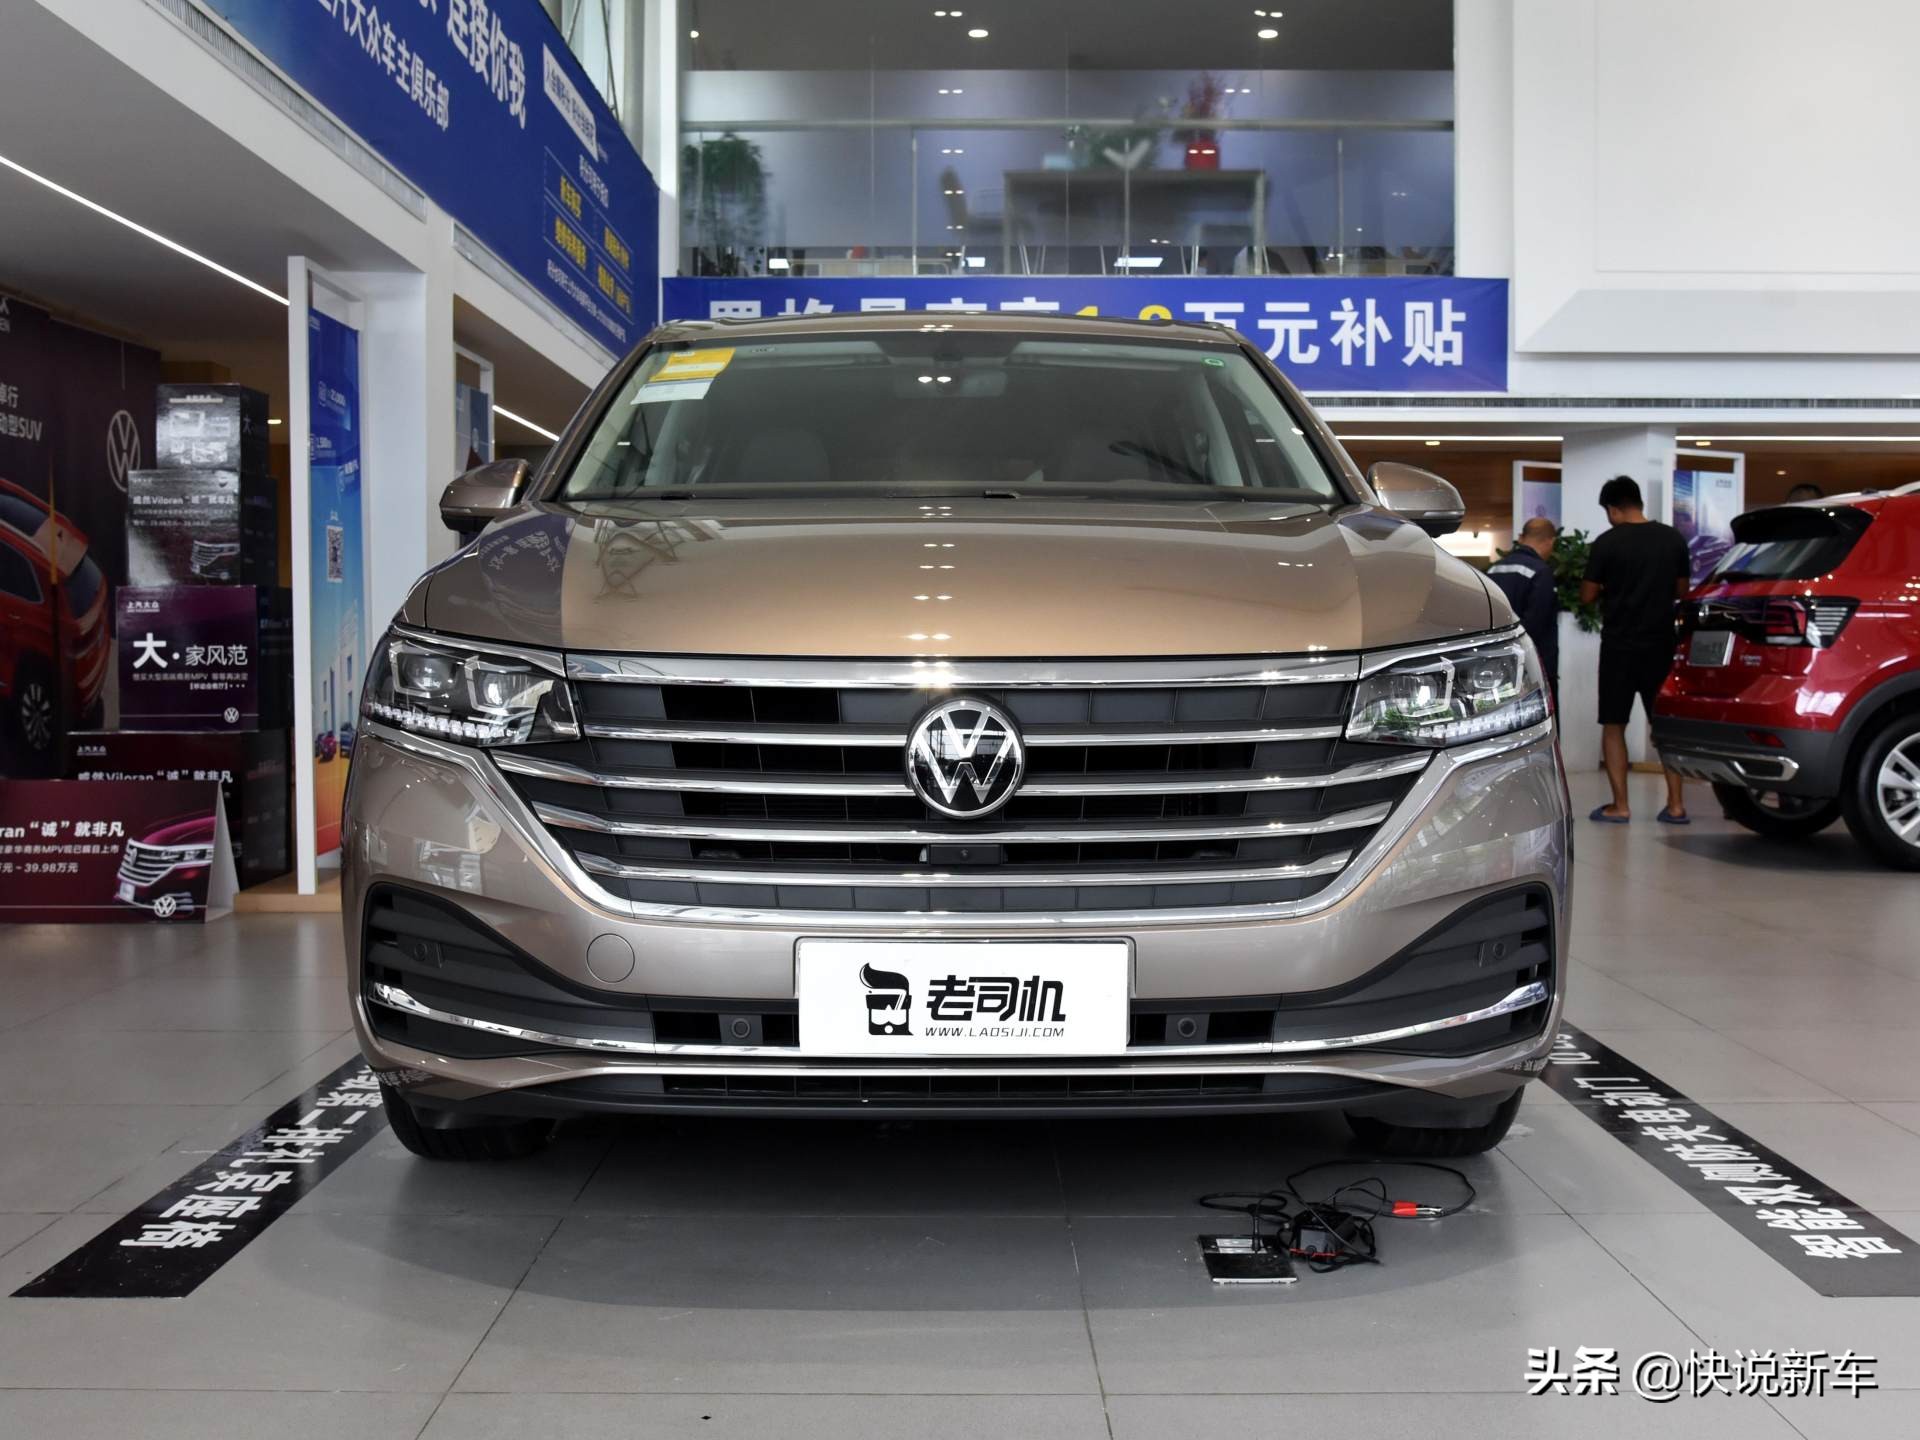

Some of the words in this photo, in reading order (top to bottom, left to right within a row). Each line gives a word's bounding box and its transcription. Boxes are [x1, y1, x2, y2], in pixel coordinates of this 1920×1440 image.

[926, 975, 1067, 1022] 老司机
[925, 1026, 1065, 1038] WWW.LAOSIJI.COM
[1573, 1076, 1903, 1261] 智能双侧防夹电动门
